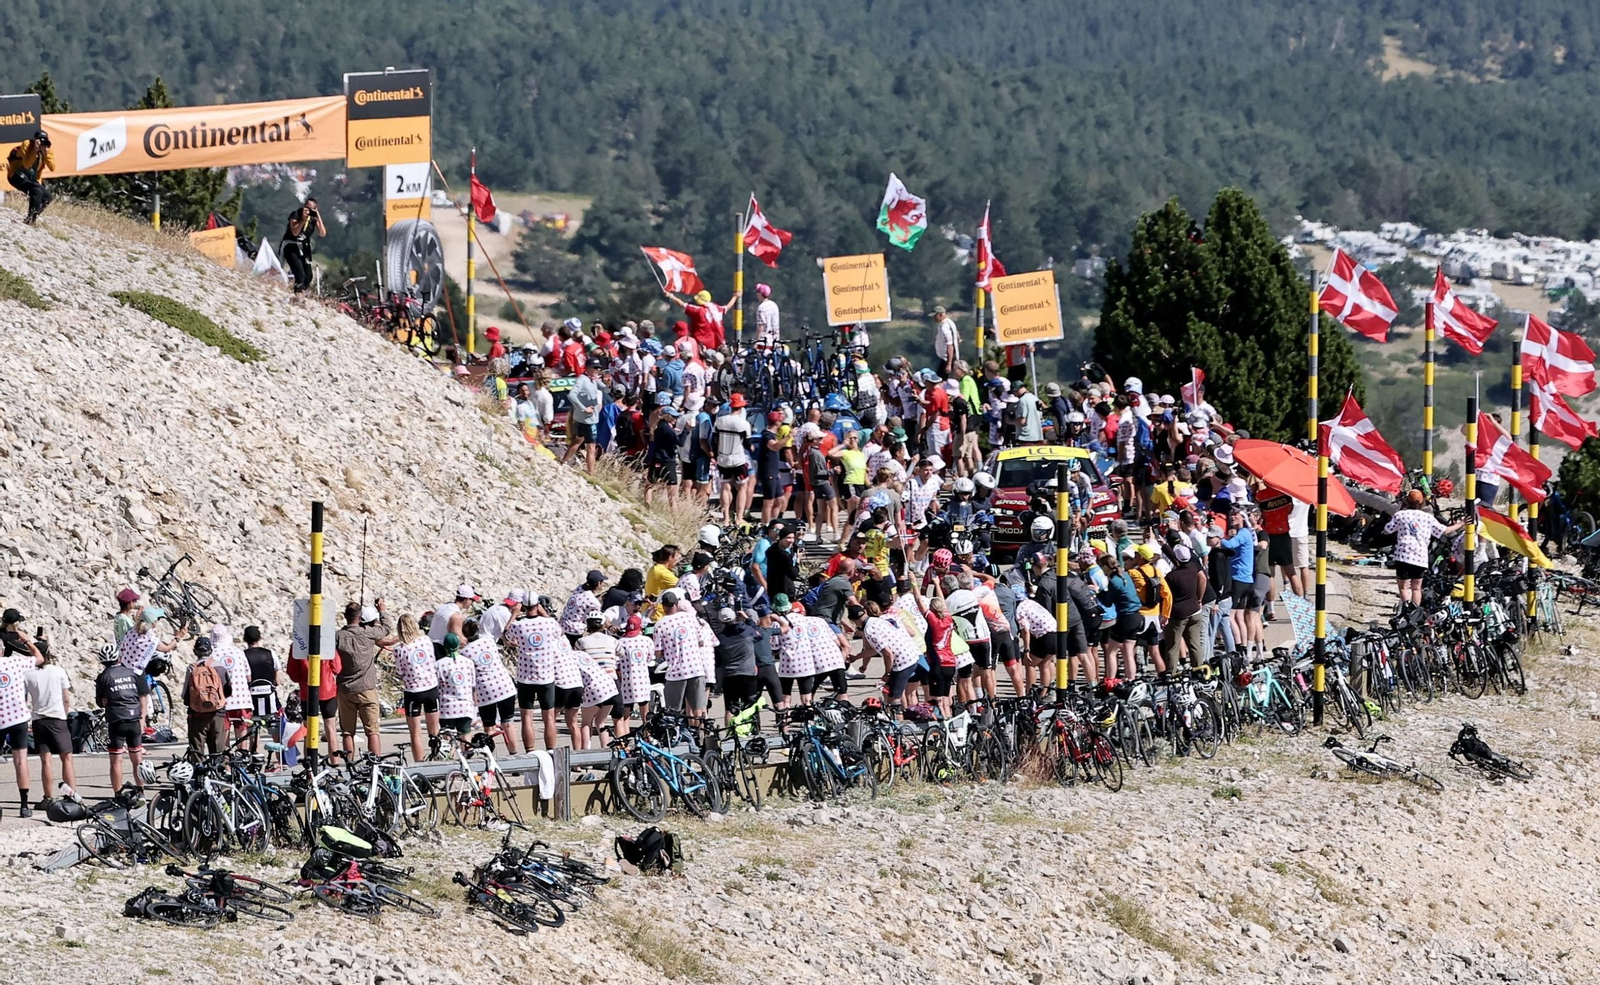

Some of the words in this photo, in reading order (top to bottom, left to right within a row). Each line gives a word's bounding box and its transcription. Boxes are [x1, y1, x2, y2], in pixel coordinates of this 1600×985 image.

[354, 87, 414, 106] Continental
[143, 116, 292, 159] Continental
[355, 134, 414, 151] Continental
[89, 137, 97, 159] 2
[100, 139, 116, 154] KM
[396, 175, 404, 193] 2
[406, 182, 421, 192] KM
[830, 260, 872, 273] Continental
[832, 282, 874, 295] Continental
[997, 277, 1041, 293] Continental
[834, 305, 876, 318] Continental
[1000, 300, 1044, 316] Continental
[1003, 323, 1048, 339] Continental
[1028, 447, 1058, 455] LCL
